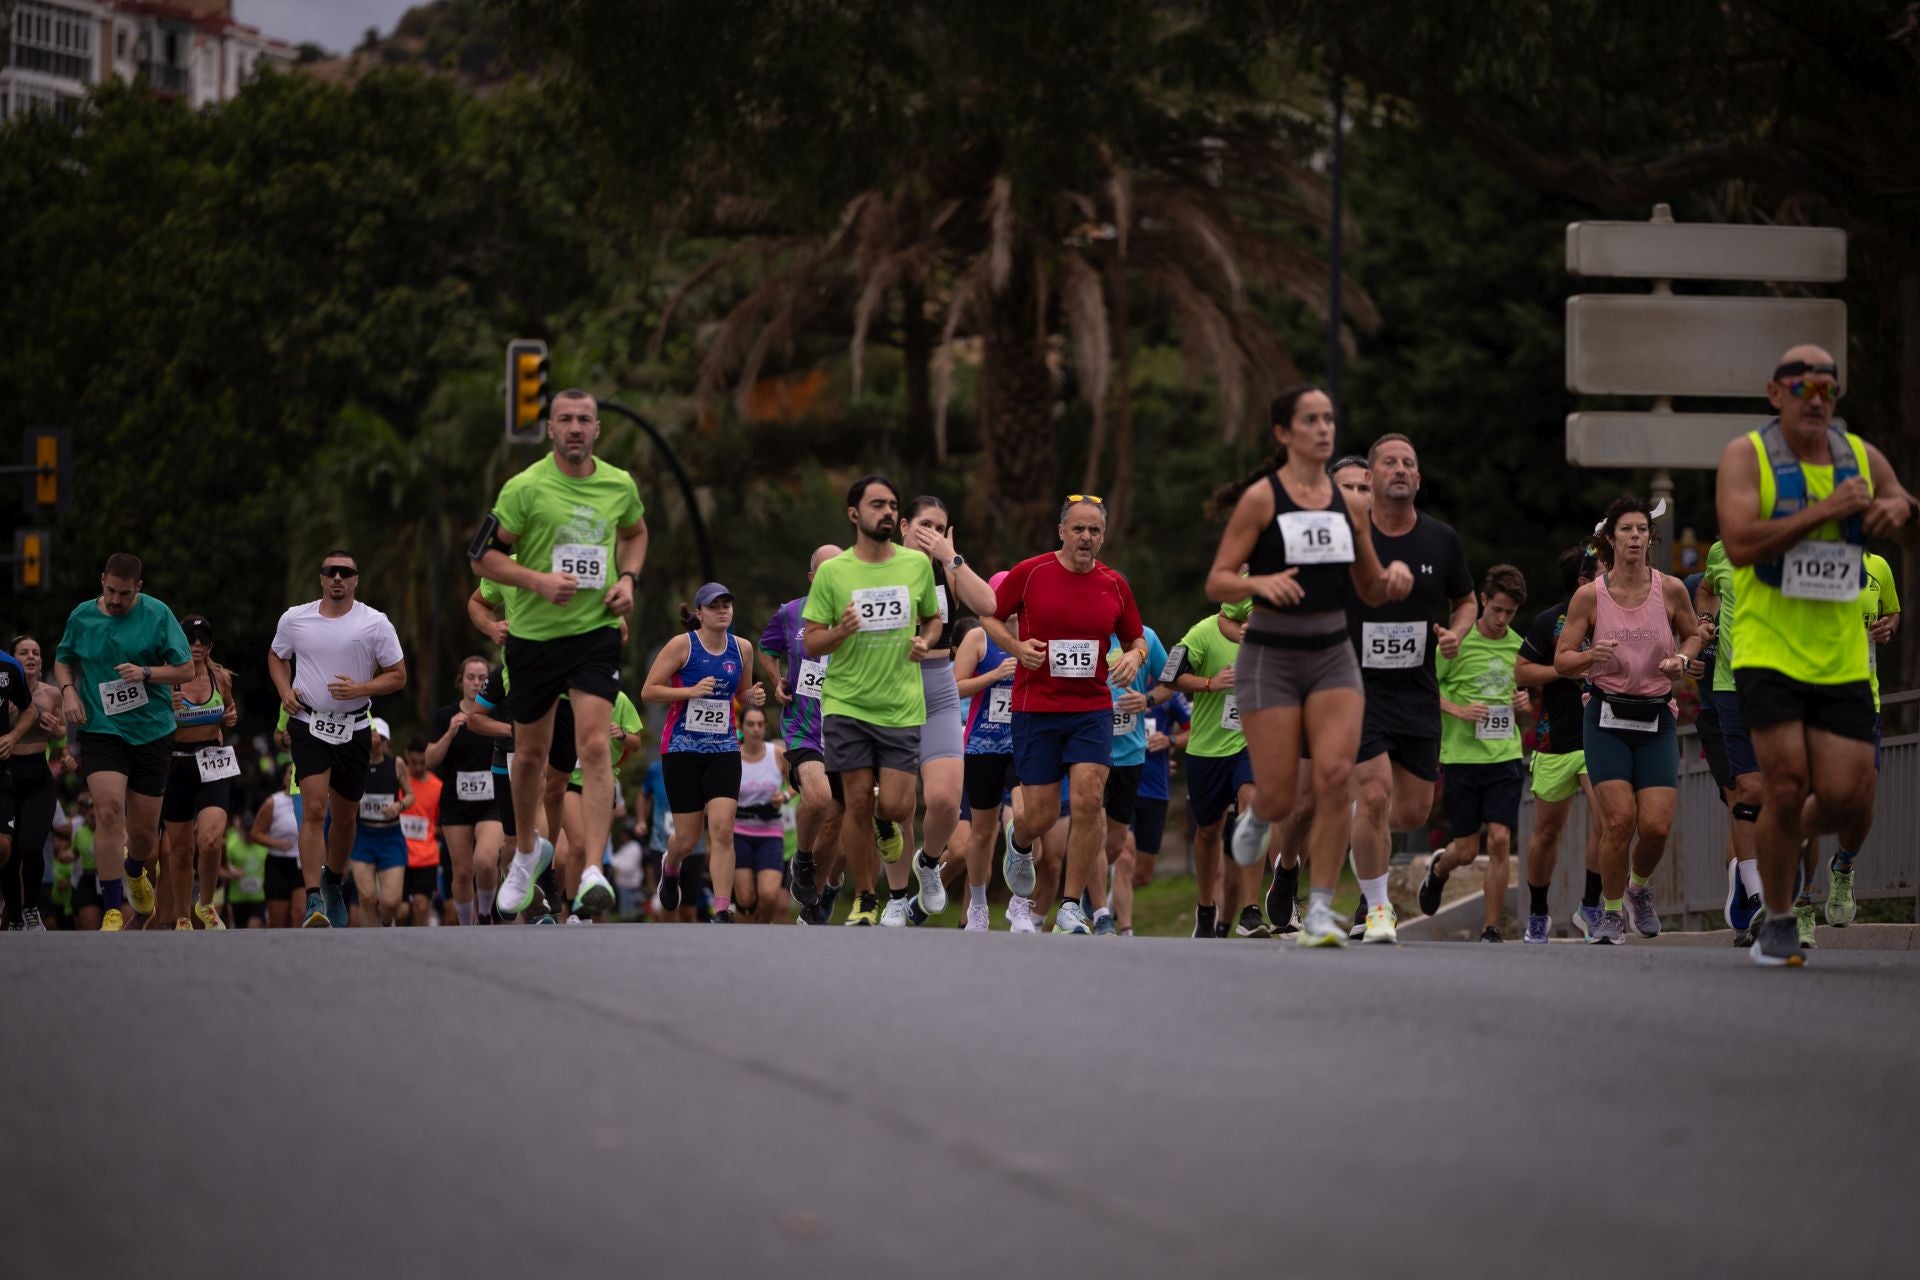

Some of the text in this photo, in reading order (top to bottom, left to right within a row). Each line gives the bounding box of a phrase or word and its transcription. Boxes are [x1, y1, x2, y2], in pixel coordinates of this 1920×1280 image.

[1302, 529, 1332, 546] 16
[562, 559, 600, 576] 569
[1792, 560, 1851, 580] 1027
[861, 601, 902, 618] 373
[1606, 628, 1661, 642] adidas
[1372, 639, 1417, 654] 554
[1056, 653, 1091, 666] 315
[107, 687, 139, 705] 768
[179, 708, 223, 719] TORREMOLINOS
[694, 710, 724, 723] 722
[314, 720, 346, 736] 837
[1483, 717, 1510, 729] 799
[202, 757, 231, 771] 1137
[461, 782, 487, 793] 257
